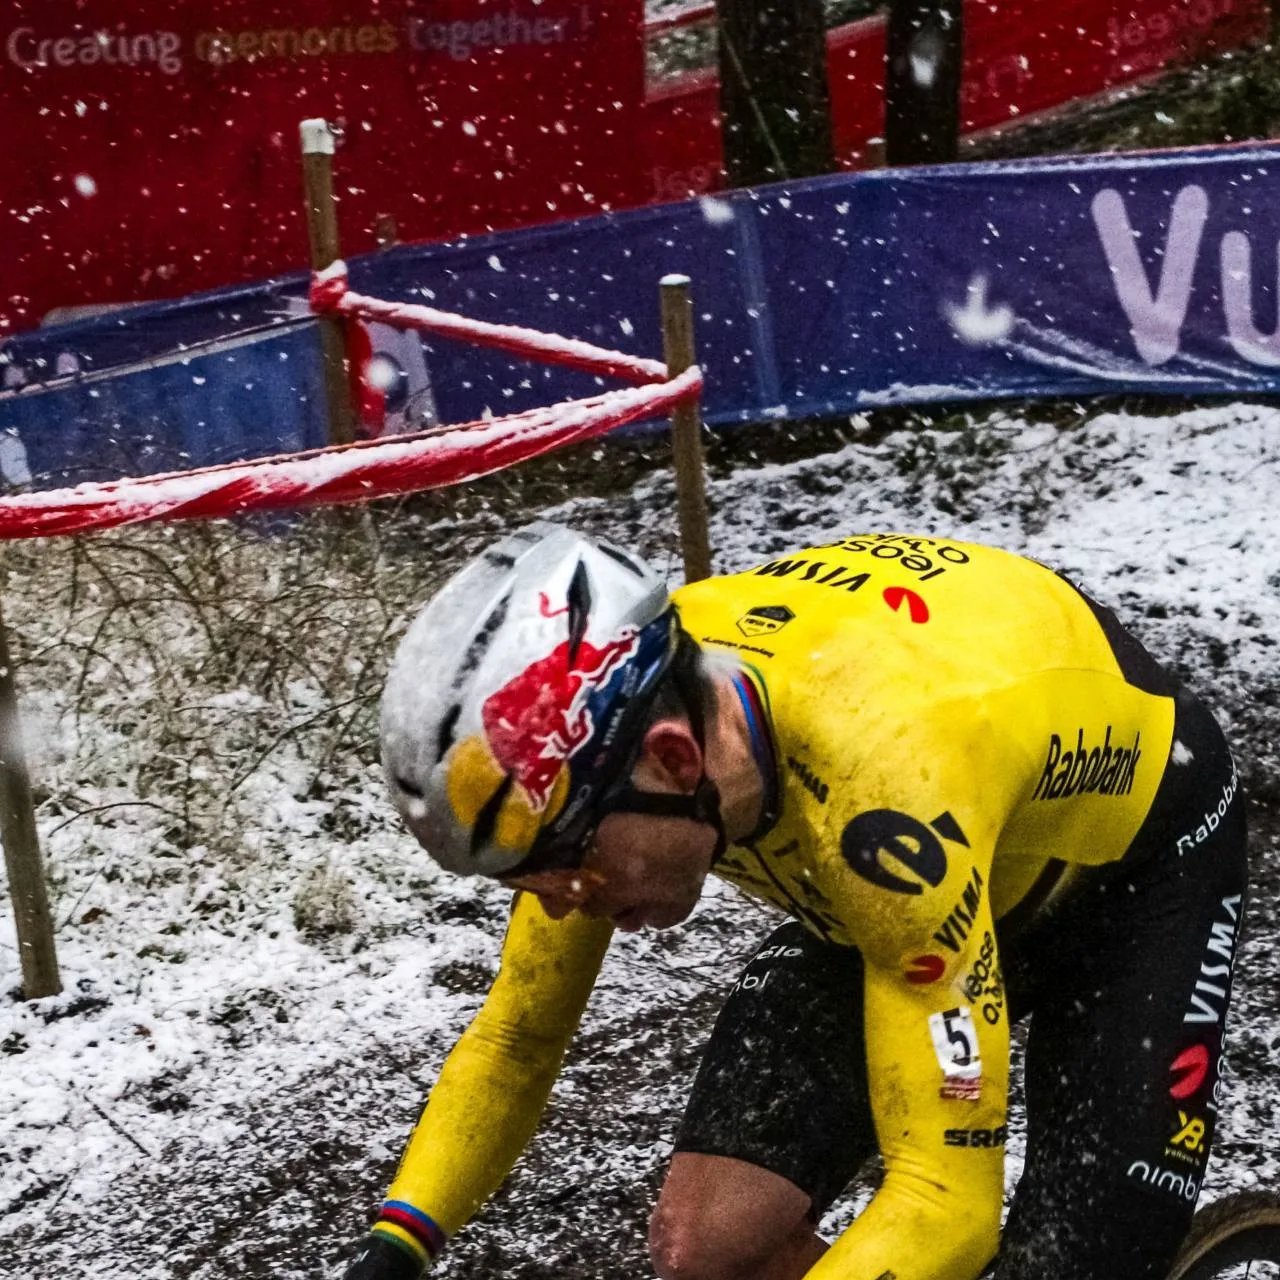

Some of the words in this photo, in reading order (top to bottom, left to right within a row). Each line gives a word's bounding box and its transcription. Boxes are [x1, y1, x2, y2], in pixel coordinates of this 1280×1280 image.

[7, 27, 181, 75] Creating
[408, 10, 568, 60] together
[1031, 725, 1141, 801] Rabobank
[1183, 893, 1242, 1024] VISMA
[942, 1007, 971, 1067] 5
